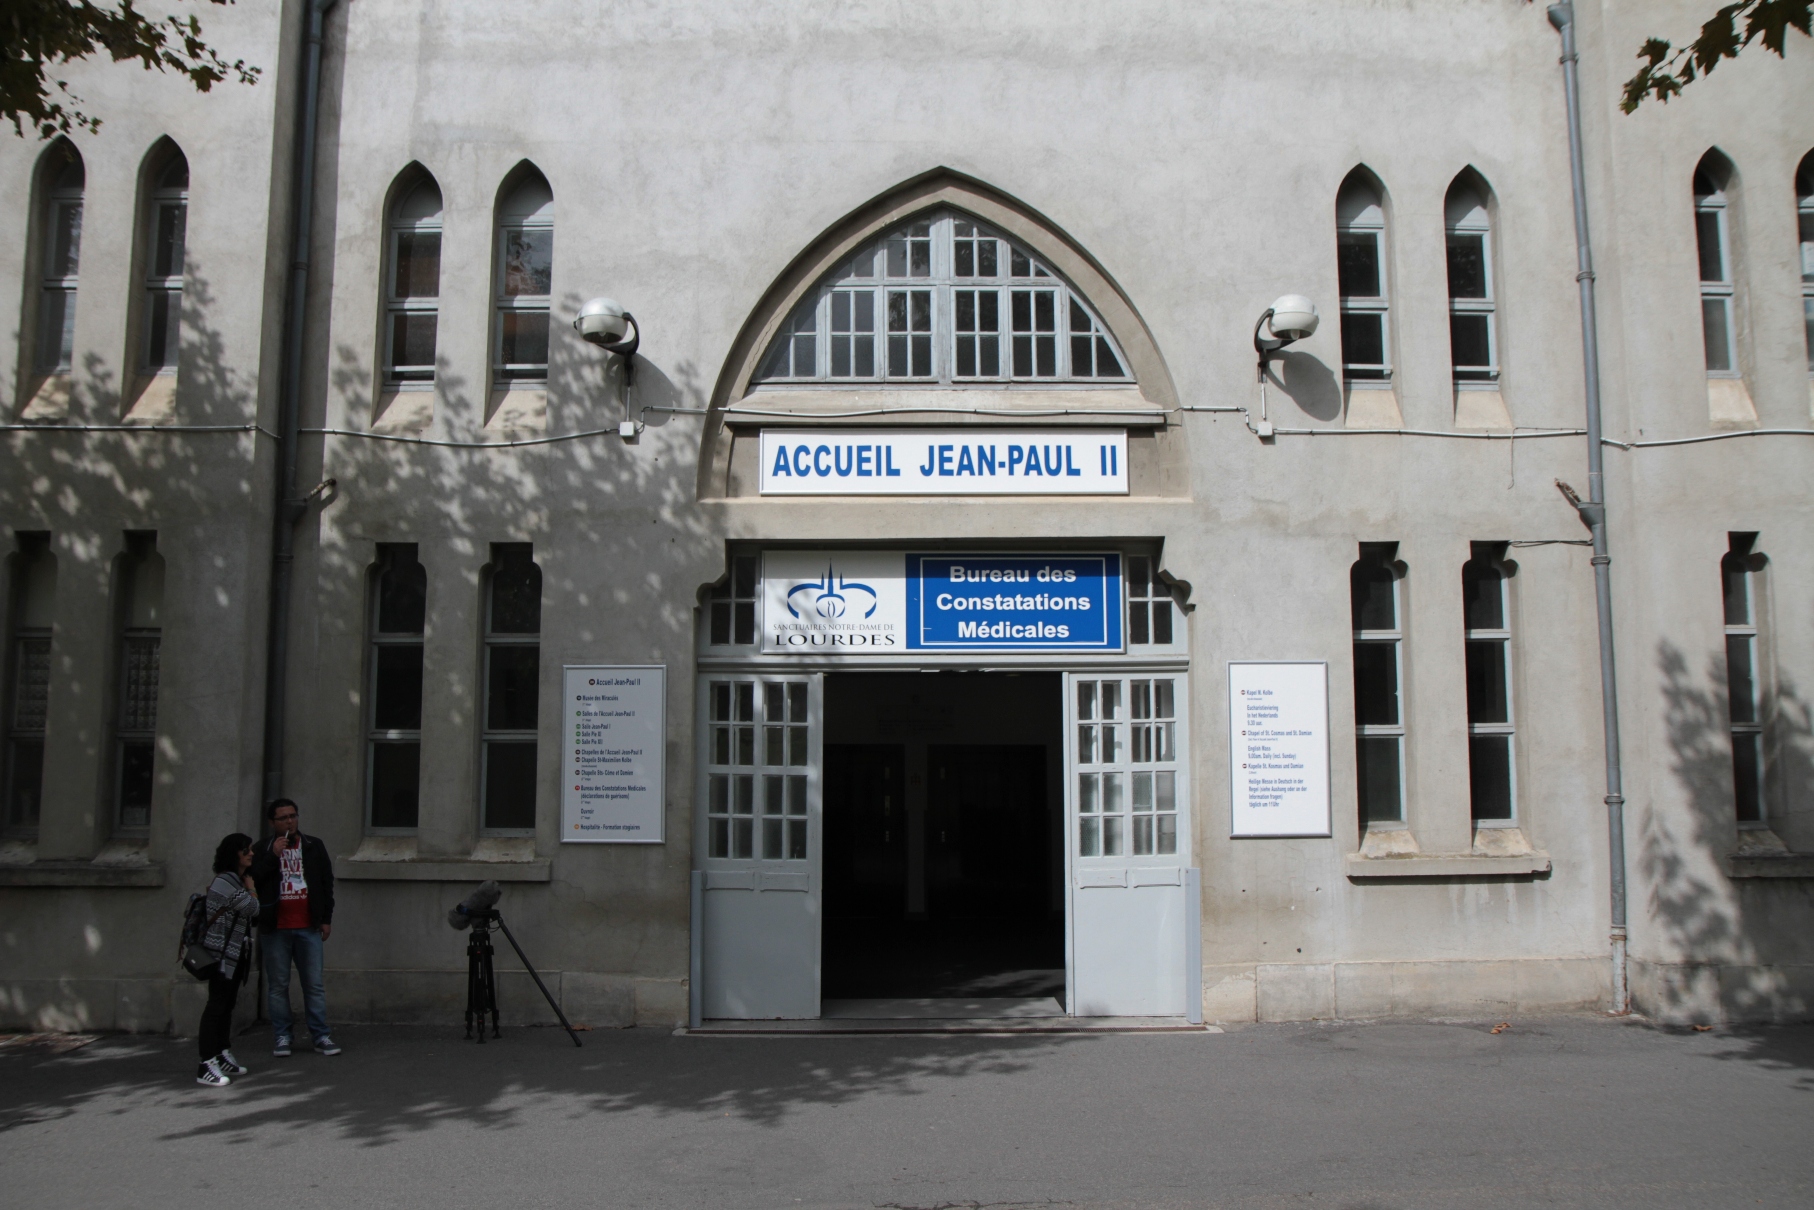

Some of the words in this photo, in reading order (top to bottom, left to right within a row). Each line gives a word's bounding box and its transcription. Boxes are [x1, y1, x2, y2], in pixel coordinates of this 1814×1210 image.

[772, 445, 901, 477] ACCUEIL
[919, 445, 1081, 477] JEAN-PAUL
[1100, 445, 1118, 477] II
[950, 565, 1029, 583] Bureau
[1035, 565, 1077, 583] des
[936, 593, 1091, 611] Constatations
[773, 623, 827, 631] SANCTUAIRES
[828, 623, 882, 631] NOTRE-DAME
[884, 623, 894, 631] DE
[958, 620, 1070, 639] Médicales
[775, 634, 895, 647] LOURDES
